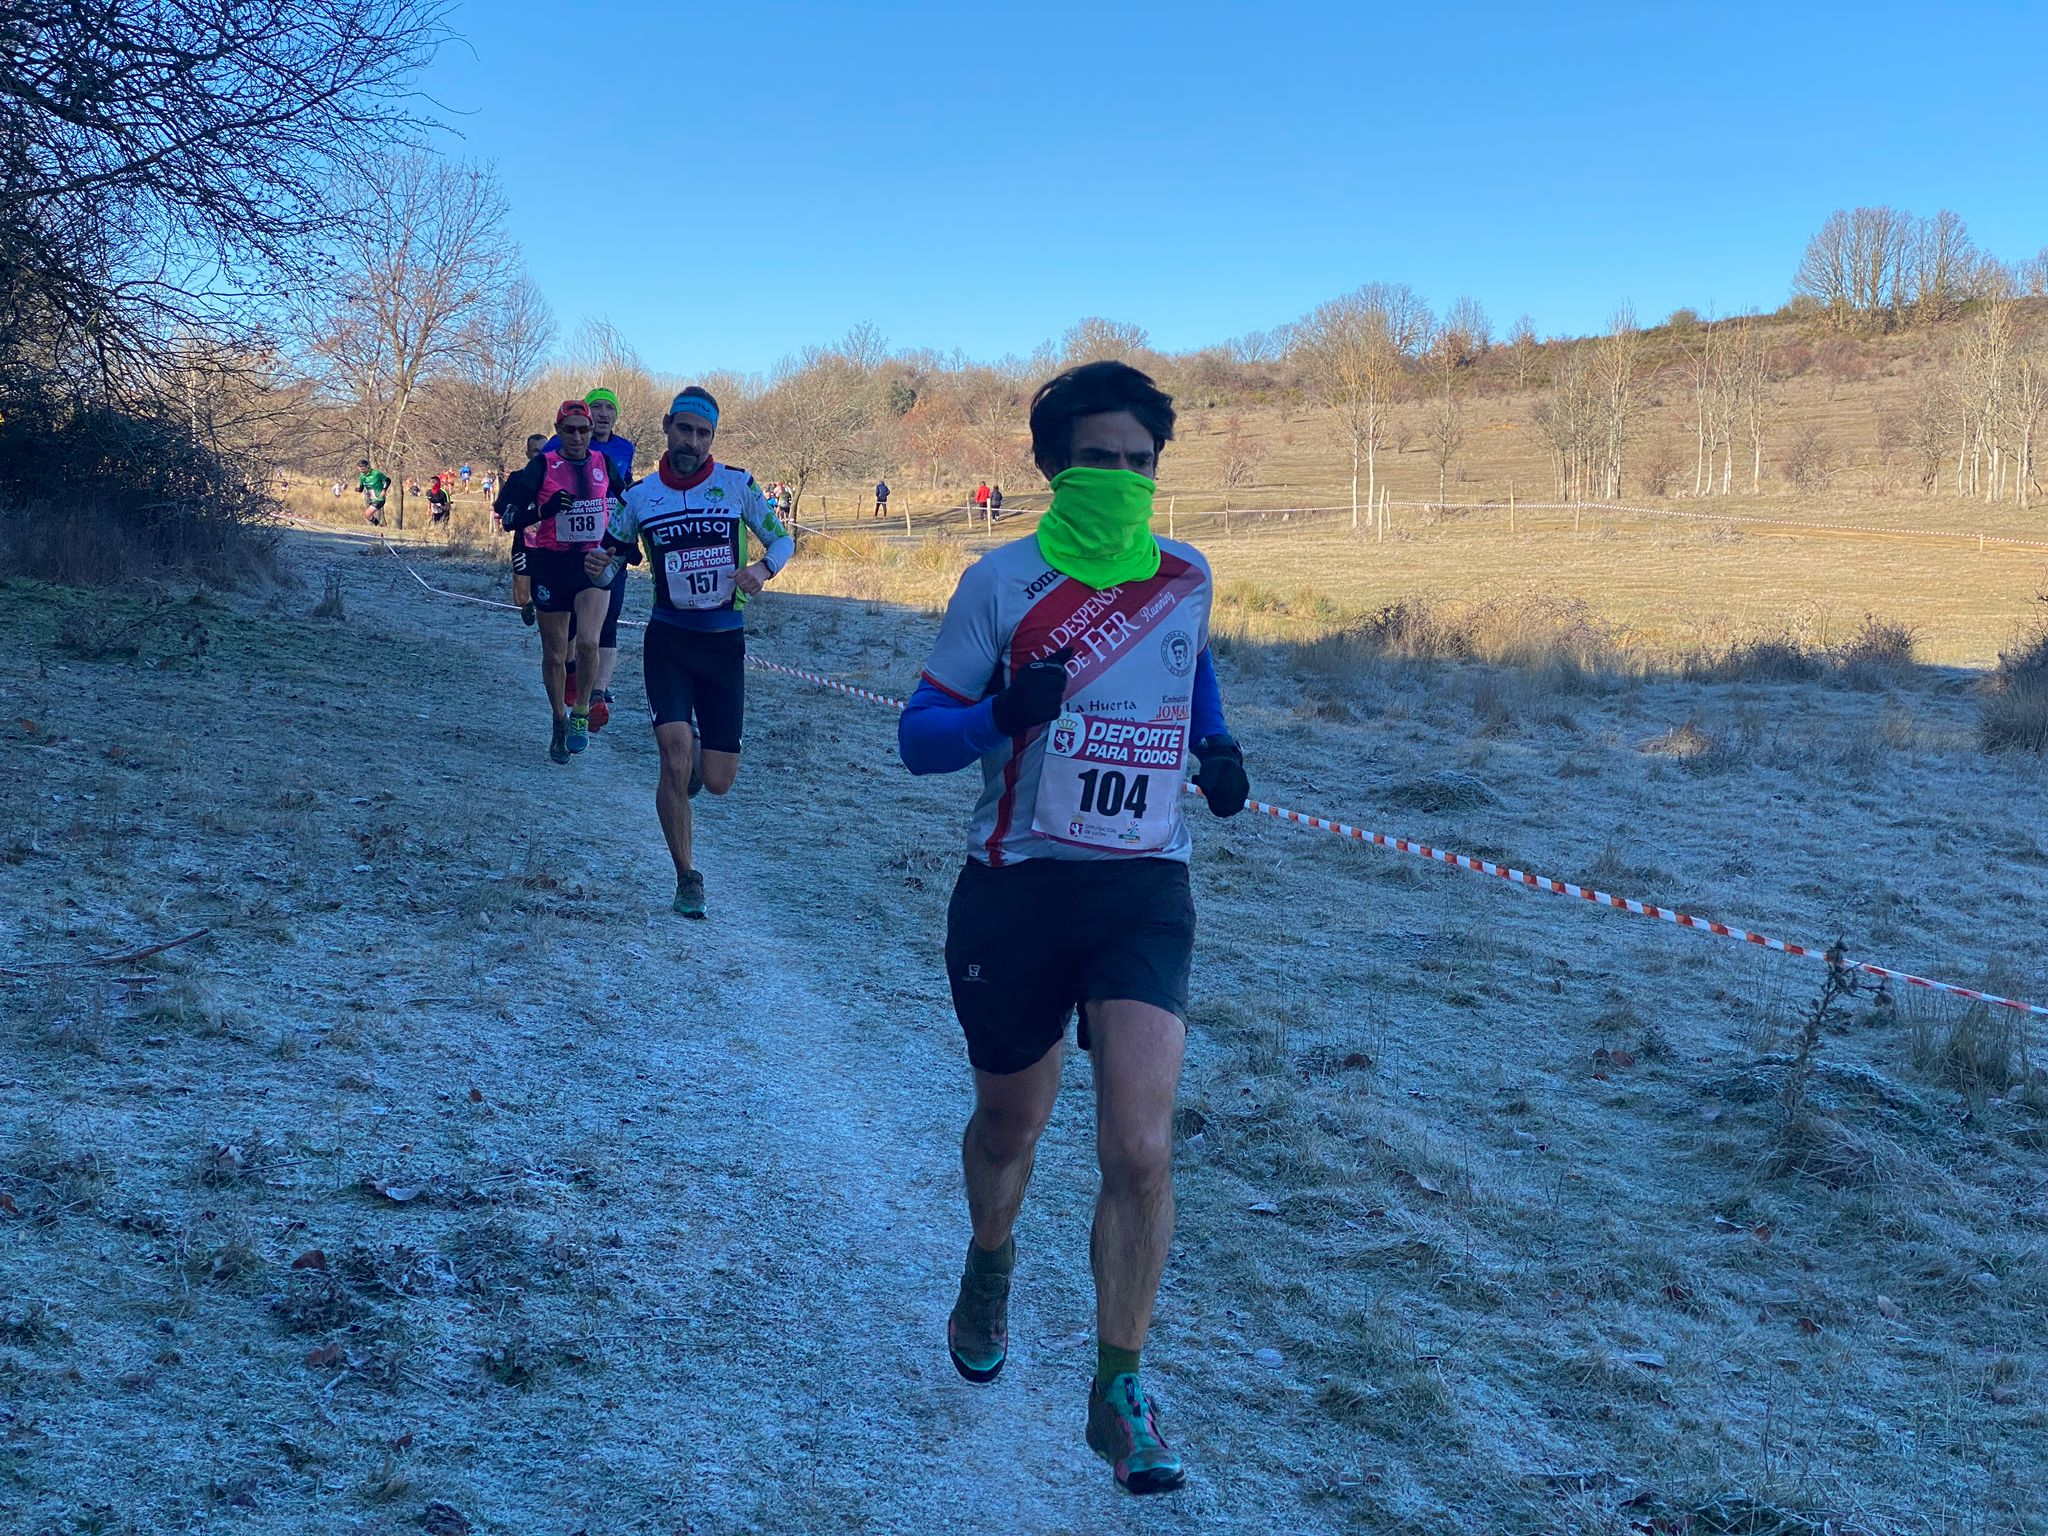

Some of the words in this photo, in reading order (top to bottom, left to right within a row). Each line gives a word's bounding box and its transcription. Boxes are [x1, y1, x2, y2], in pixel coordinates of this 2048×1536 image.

[571, 499, 602, 508] EPORTE
[568, 515, 595, 532] 138
[682, 546, 731, 562] DEPORTE
[683, 560, 704, 569] PARA
[706, 556, 731, 566] TODOS
[686, 570, 718, 595] 157
[1048, 586, 1124, 649] DESPENSA
[1064, 651, 1091, 679] DE
[1080, 610, 1141, 663] FER
[1090, 700, 1137, 712] Huerta
[1088, 721, 1182, 749] DEPORTE
[1085, 742, 1128, 762] PARA
[1133, 748, 1178, 765] TODOS
[1078, 769, 1149, 819] 104
